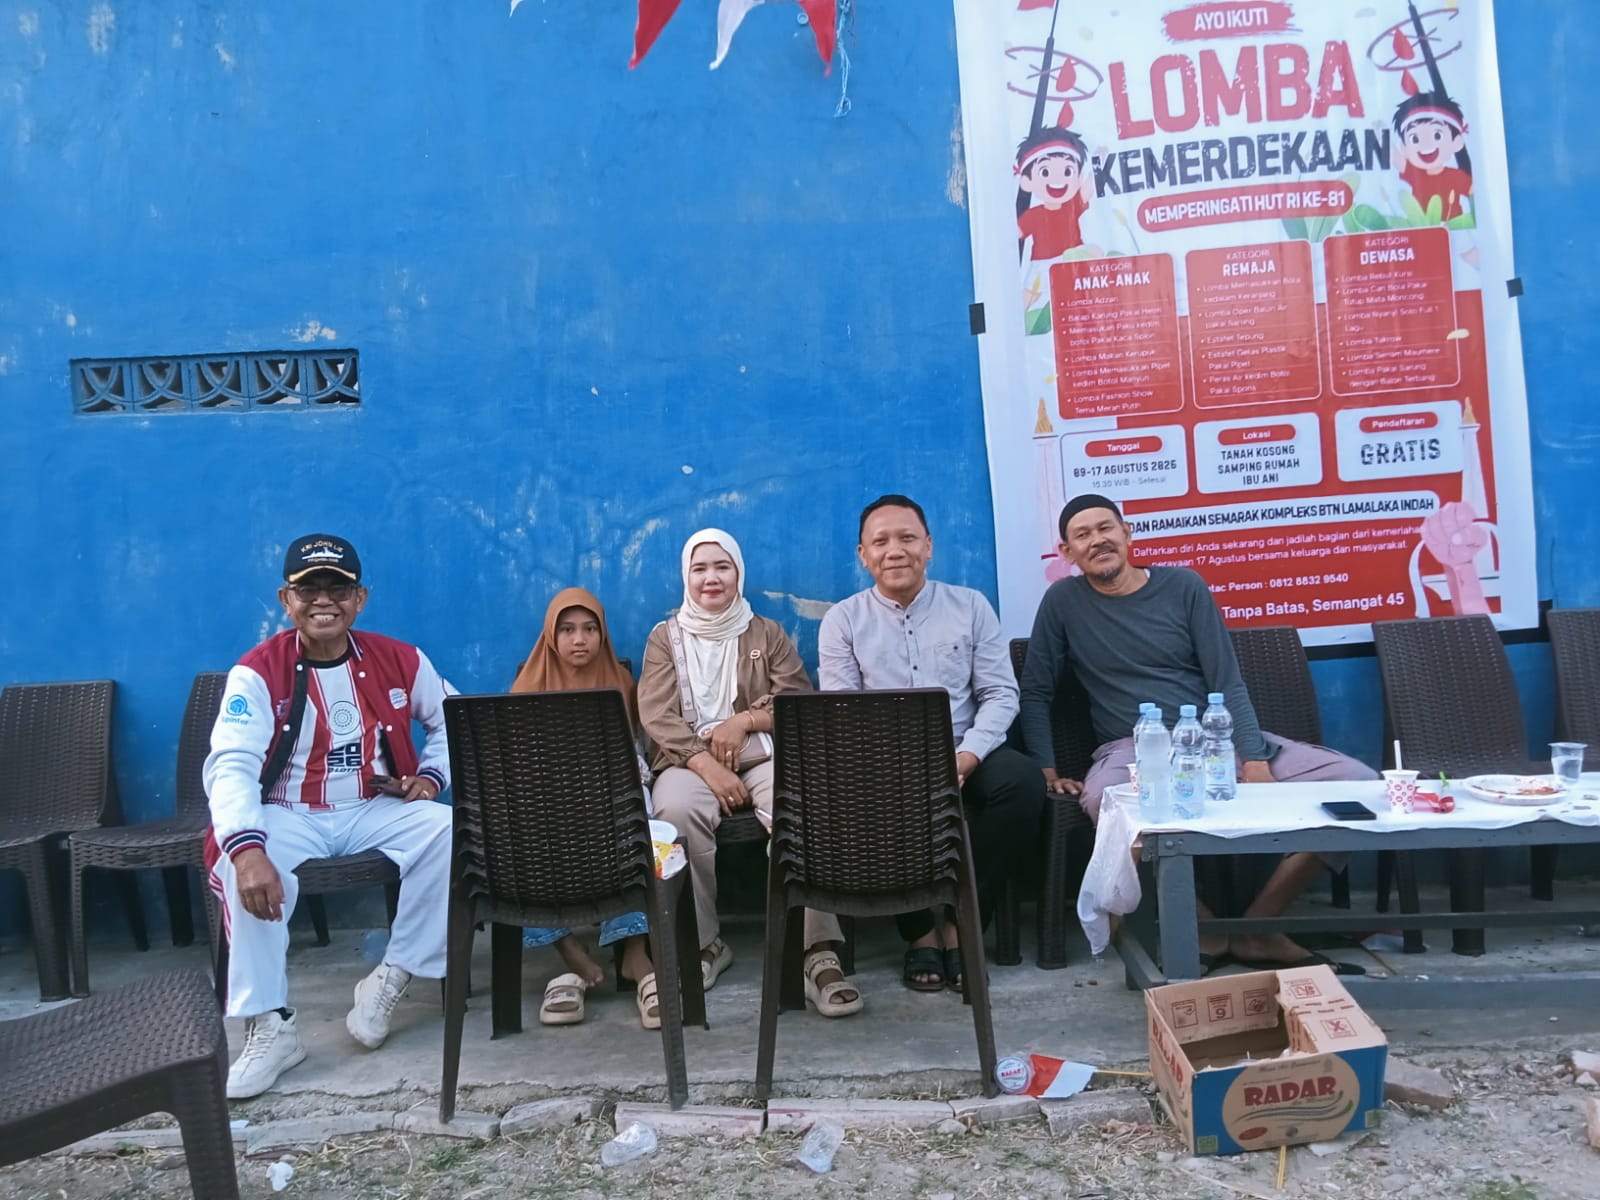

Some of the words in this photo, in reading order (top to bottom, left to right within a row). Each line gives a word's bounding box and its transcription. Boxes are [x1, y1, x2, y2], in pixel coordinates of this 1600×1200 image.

[1194, 12, 1226, 31] AYO
[1227, 7, 1268, 28] IKUTI
[1108, 40, 1365, 140] LOMBA
[1091, 128, 1391, 198] KEMERDEKAAN
[1144, 195, 1252, 225] MEMPERINGATI
[1252, 192, 1285, 210] HUT
[1286, 191, 1301, 208] RI
[1302, 189, 1345, 208] KE-81
[1365, 236, 1409, 247] KATEGORI
[1226, 249, 1270, 260] KATEGORI
[1360, 247, 1415, 265] DEWASA
[1089, 262, 1133, 273] KATEGORI
[1222, 260, 1276, 277] REMAJA
[1073, 271, 1151, 291] ANAK-ANAK
[1342, 287, 1369, 295] Lomba
[1067, 298, 1093, 307] Lomba
[1345, 338, 1373, 347] Lomba
[1070, 354, 1097, 363] Lomba
[1347, 353, 1374, 362] Lomba
[1072, 369, 1098, 378] Lomba
[1348, 367, 1375, 376] Lomba
[1074, 395, 1100, 404] Lomba
[1371, 416, 1426, 429] Pendaftaran
[1242, 430, 1271, 440] Lokasi
[1107, 441, 1140, 453] Tanggal
[1220, 447, 1254, 461] TANAH
[1256, 444, 1296, 458] KOSONG
[1360, 438, 1441, 466] GRATIS
[1073, 466, 1102, 478] 09-17
[1104, 462, 1149, 476] AGUSTUS
[1151, 459, 1177, 471] 2026
[1217, 461, 1263, 475] SAMPING
[1264, 457, 1301, 472] RUMAH
[1242, 475, 1260, 486] IBU
[1261, 473, 1279, 485] ANI
[1151, 513, 1207, 530] RAMAIKAN
[1208, 509, 1260, 525] SEMARAK
[1261, 505, 1317, 521] KOMPLEKS
[1318, 502, 1341, 516] BTN
[1342, 499, 1400, 515] LAMALAKA
[1400, 497, 1434, 511] INDAH
[1133, 545, 1179, 557] Daftarkan
[1179, 542, 1194, 553] diri
[1196, 541, 1220, 552] Anda
[1222, 539, 1265, 551] sekarang
[1266, 536, 1285, 546] dan
[1286, 534, 1317, 547] jadilah
[1318, 531, 1350, 545] bagian
[1352, 528, 1370, 539] dari
[1196, 556, 1206, 565] 17
[1208, 554, 1246, 566] Agustus
[1248, 551, 1289, 561] bersama
[1291, 546, 1332, 558] keluarga
[1333, 544, 1351, 554] dan
[1353, 540, 1407, 553] masyarakat.
[1228, 580, 1263, 592] Person
[1269, 577, 1293, 588] 0812
[1295, 575, 1321, 586] 8832
[1323, 573, 1349, 584] 9540
[1221, 604, 1263, 620] Tanpa
[1266, 601, 1309, 616] Batas,
[1312, 594, 1383, 612] Semangat
[1386, 592, 1405, 606] 45
[1215, 1006, 1226, 1020] 9
[1243, 1075, 1337, 1107] RADAR
